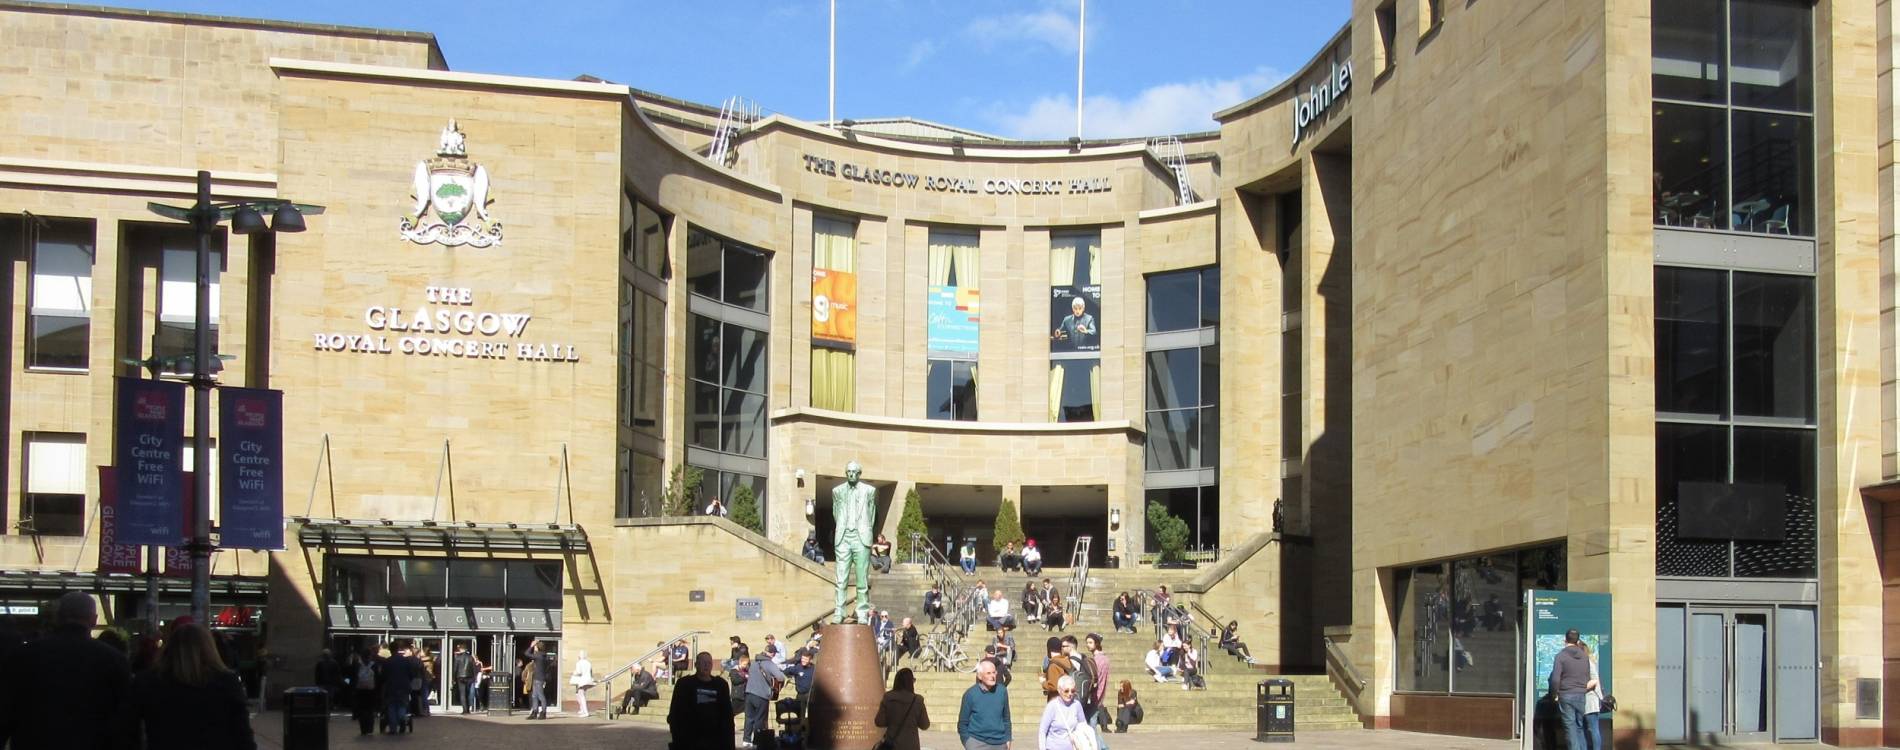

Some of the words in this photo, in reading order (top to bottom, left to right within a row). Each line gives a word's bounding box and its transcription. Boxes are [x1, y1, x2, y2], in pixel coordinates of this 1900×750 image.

[1293, 84, 1329, 144] John
[803, 154, 836, 177] THE
[841, 163, 919, 189] GLASGOW
[924, 175, 978, 193] ROYAL
[984, 178, 1062, 195] CONCERT
[1069, 177, 1112, 192] HALL
[426, 286, 472, 304] THE
[365, 305, 530, 337] GLASGOW
[314, 333, 391, 353] ROYAL
[399, 336, 508, 358] CONCERT
[517, 342, 579, 362] HALL
[140, 433, 163, 447] City
[240, 440, 262, 454] City
[131, 446, 170, 459] Centre
[233, 453, 270, 465] Centre
[138, 460, 163, 472] Free
[240, 466, 264, 478] Free
[137, 473, 164, 485] WiFi
[239, 479, 264, 490] WiFi
[102, 505, 115, 565] GLASGOW
[113, 544, 125, 567] AKE
[456, 615, 548, 625] GLLERIES
